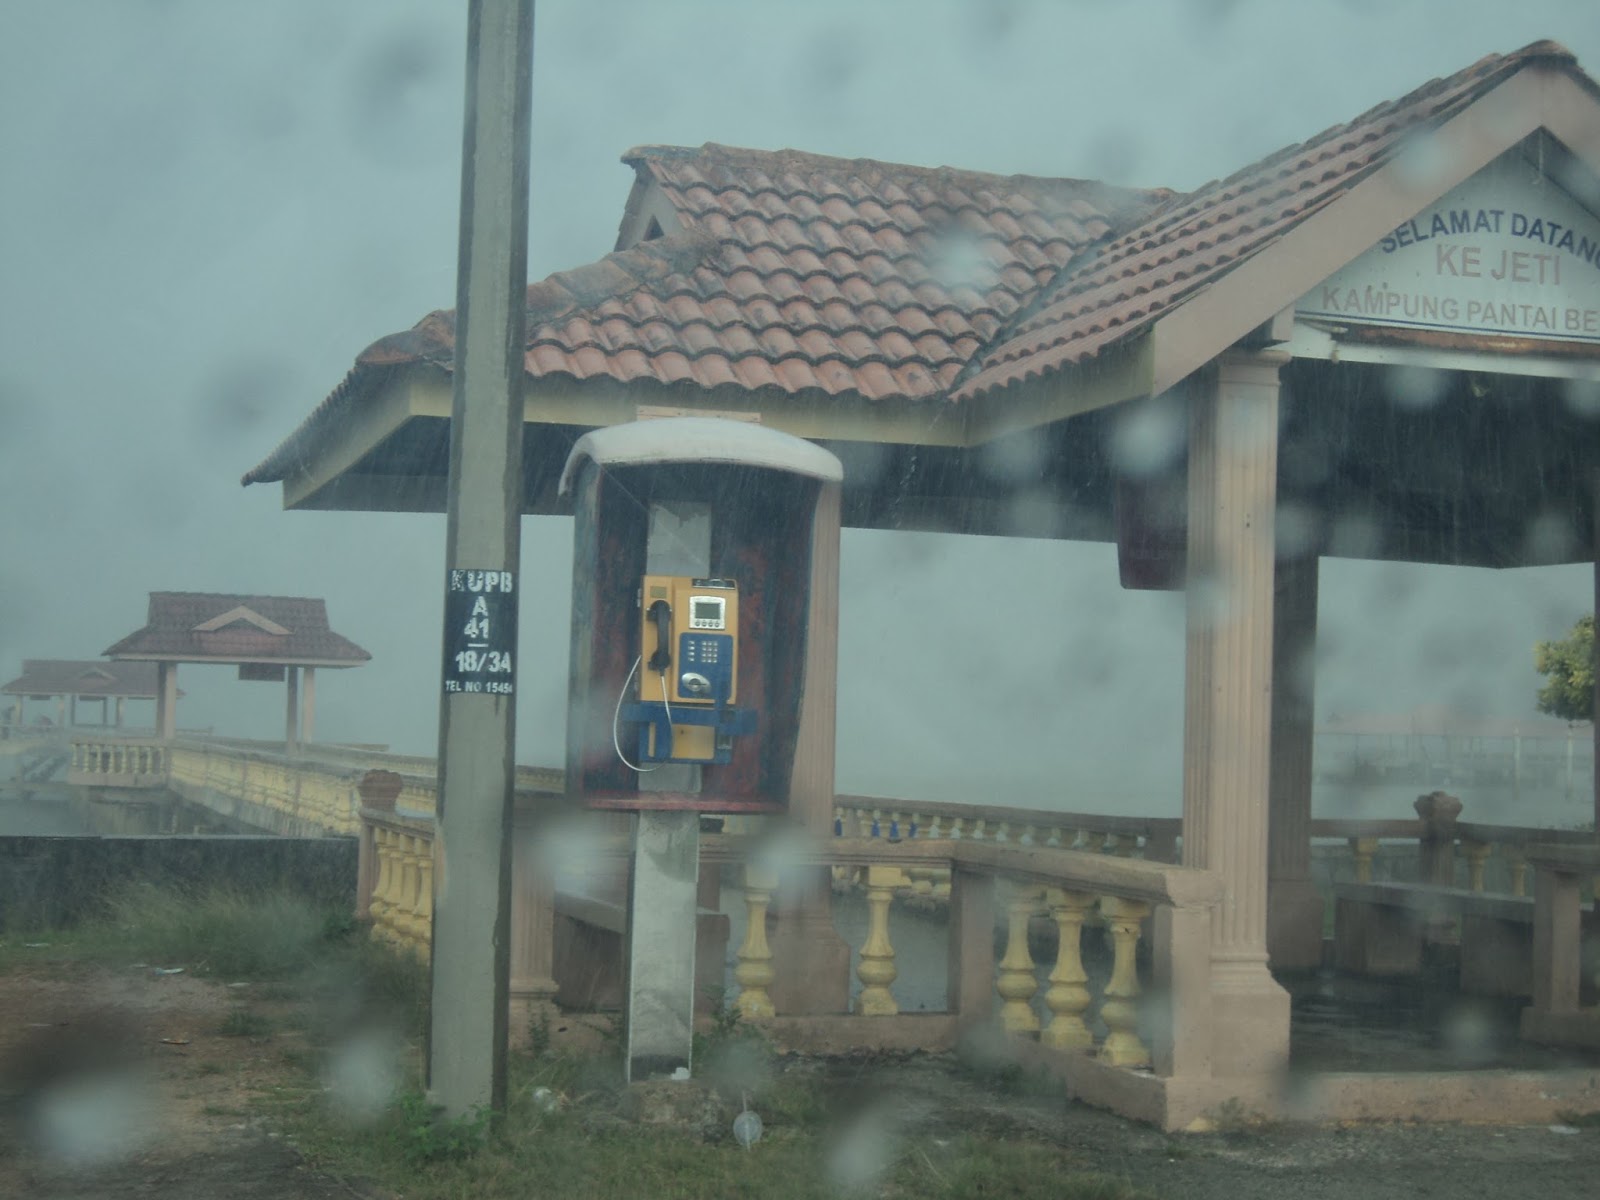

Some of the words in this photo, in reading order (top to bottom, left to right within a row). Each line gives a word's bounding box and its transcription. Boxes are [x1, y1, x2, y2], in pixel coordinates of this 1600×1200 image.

[1380, 209, 1504, 254] SELAMAT
[1436, 243, 1482, 278] KE
[1491, 249, 1561, 286] JETI
[1322, 284, 1459, 321] KAMPUNG
[1467, 301, 1556, 330] PANTAI
[451, 569, 512, 593] KUPB
[472, 596, 489, 617] A
[464, 617, 489, 639] 41
[445, 680, 462, 692] TEL
[465, 681, 482, 693] NO
